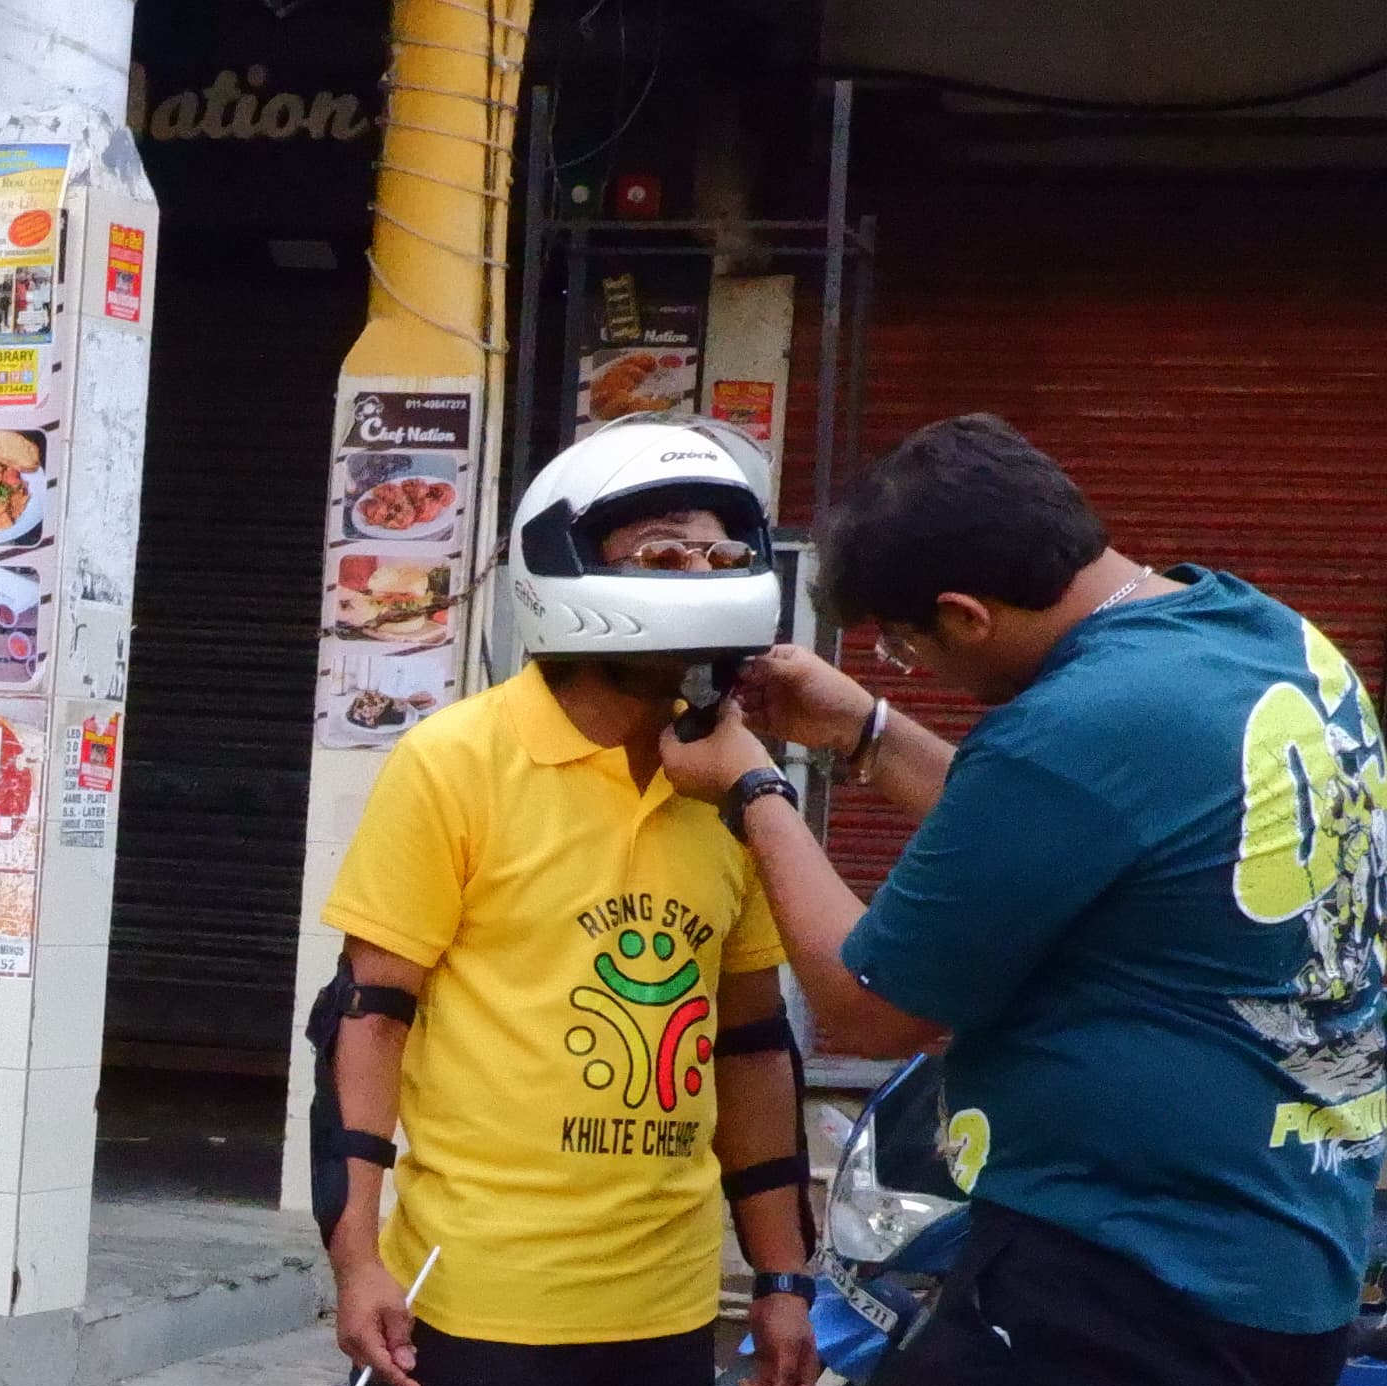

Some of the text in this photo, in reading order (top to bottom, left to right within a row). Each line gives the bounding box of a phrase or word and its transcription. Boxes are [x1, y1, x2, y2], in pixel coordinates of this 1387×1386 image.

[127, 60, 368, 141] ation
[643, 328, 689, 343] Nation
[360, 417, 456, 444] Chef Nation
[577, 893, 714, 952] RISING STAR
[562, 1115, 636, 1156] KHILTE
